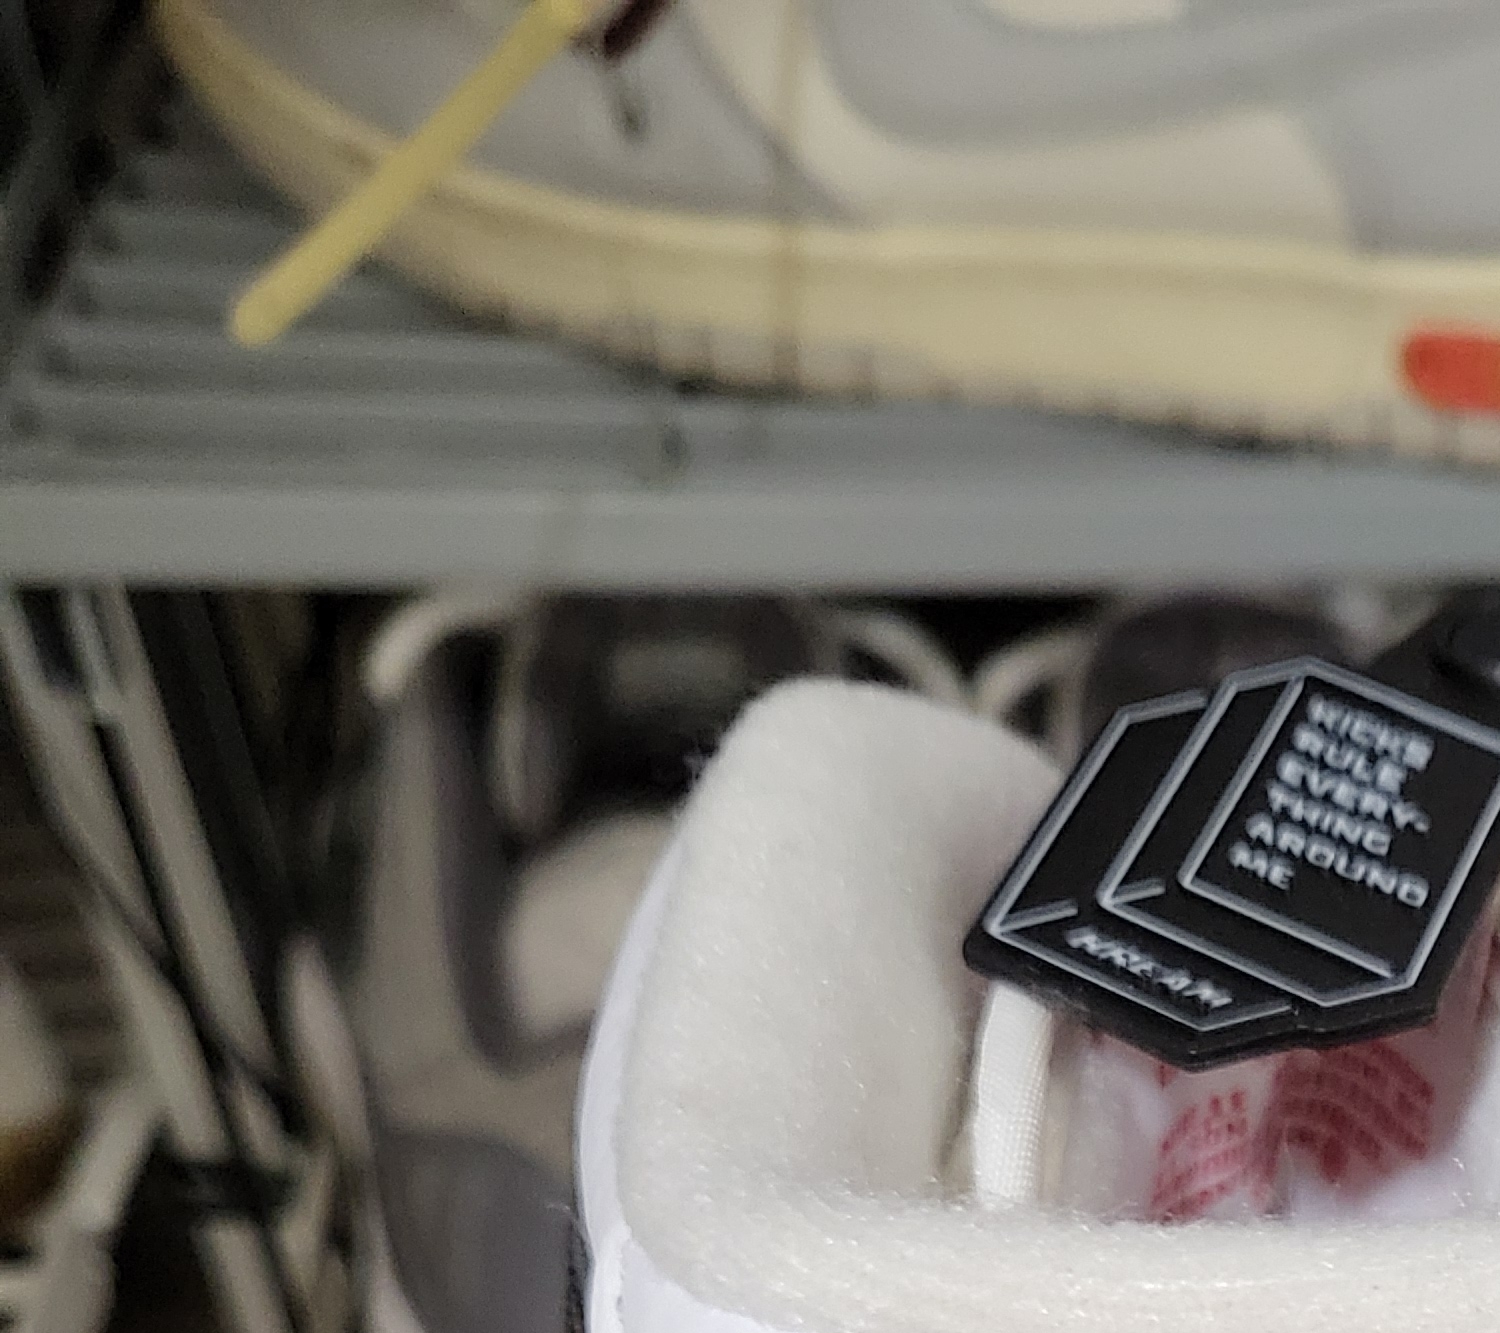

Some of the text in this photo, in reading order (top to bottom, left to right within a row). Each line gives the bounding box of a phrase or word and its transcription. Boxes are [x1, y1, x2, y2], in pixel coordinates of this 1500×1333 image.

[1293, 724, 1406, 794] RULE
[1229, 842, 1294, 890] ME
[1246, 812, 1429, 909] AROUND
